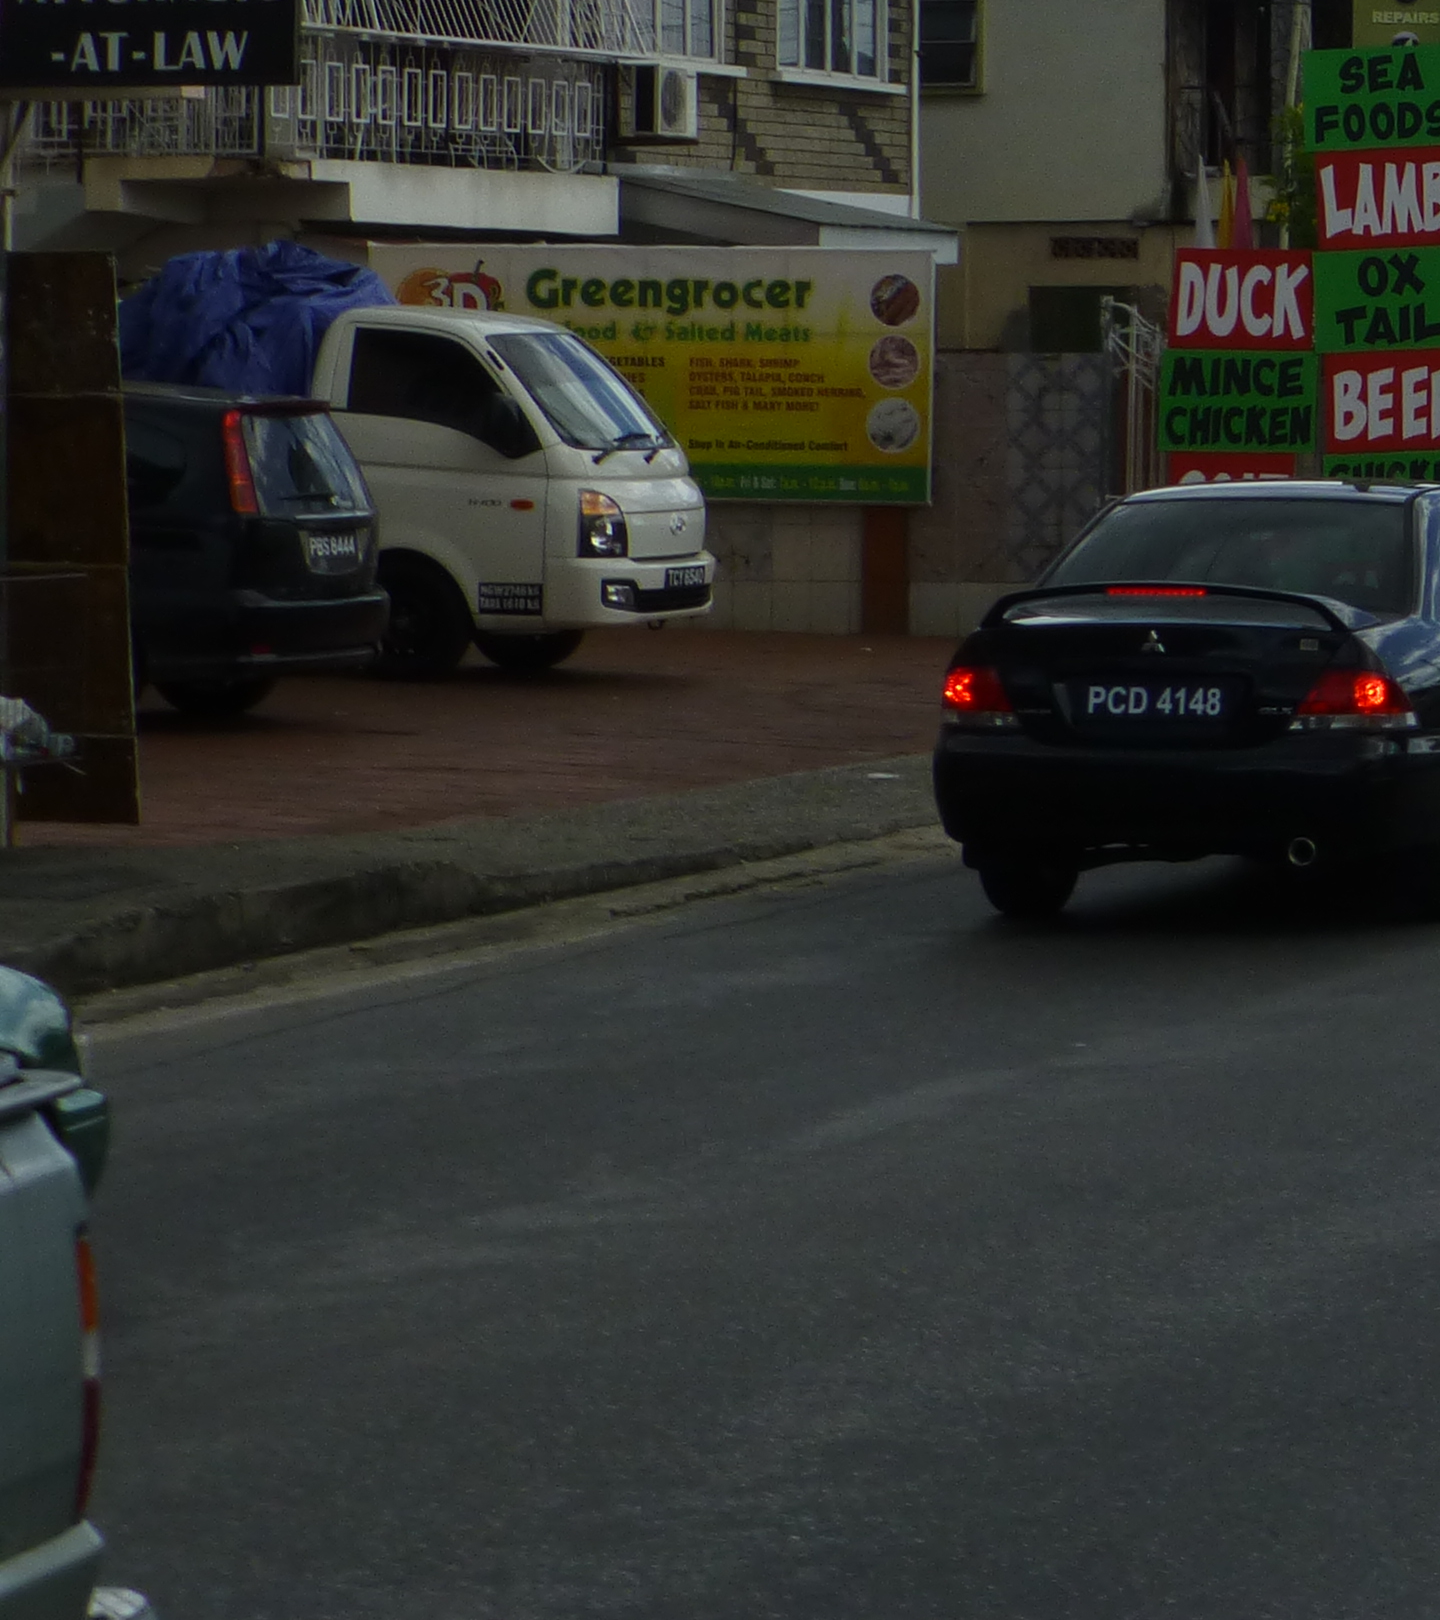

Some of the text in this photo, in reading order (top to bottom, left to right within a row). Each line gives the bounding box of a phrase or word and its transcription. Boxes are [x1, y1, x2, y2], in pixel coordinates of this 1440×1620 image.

[1372, 10, 1440, 25] REPAIRS
[1339, 51, 1426, 95] SEA
[526, 268, 812, 316] Greengrocer
[1356, 252, 1427, 298] OX
[1176, 261, 1311, 340] DUCK
[665, 319, 735, 341] Salted
[745, 322, 811, 342] Meats
[1168, 357, 1305, 400] MINCE
[715, 401, 739, 411] FISH
[1164, 403, 1314, 448] CHICKEN
[688, 439, 712, 451] Shop
[727, 440, 805, 452] Air-Conditioned
[808, 440, 848, 452] Comfort
[1087, 686, 1222, 717] PCD 4148
